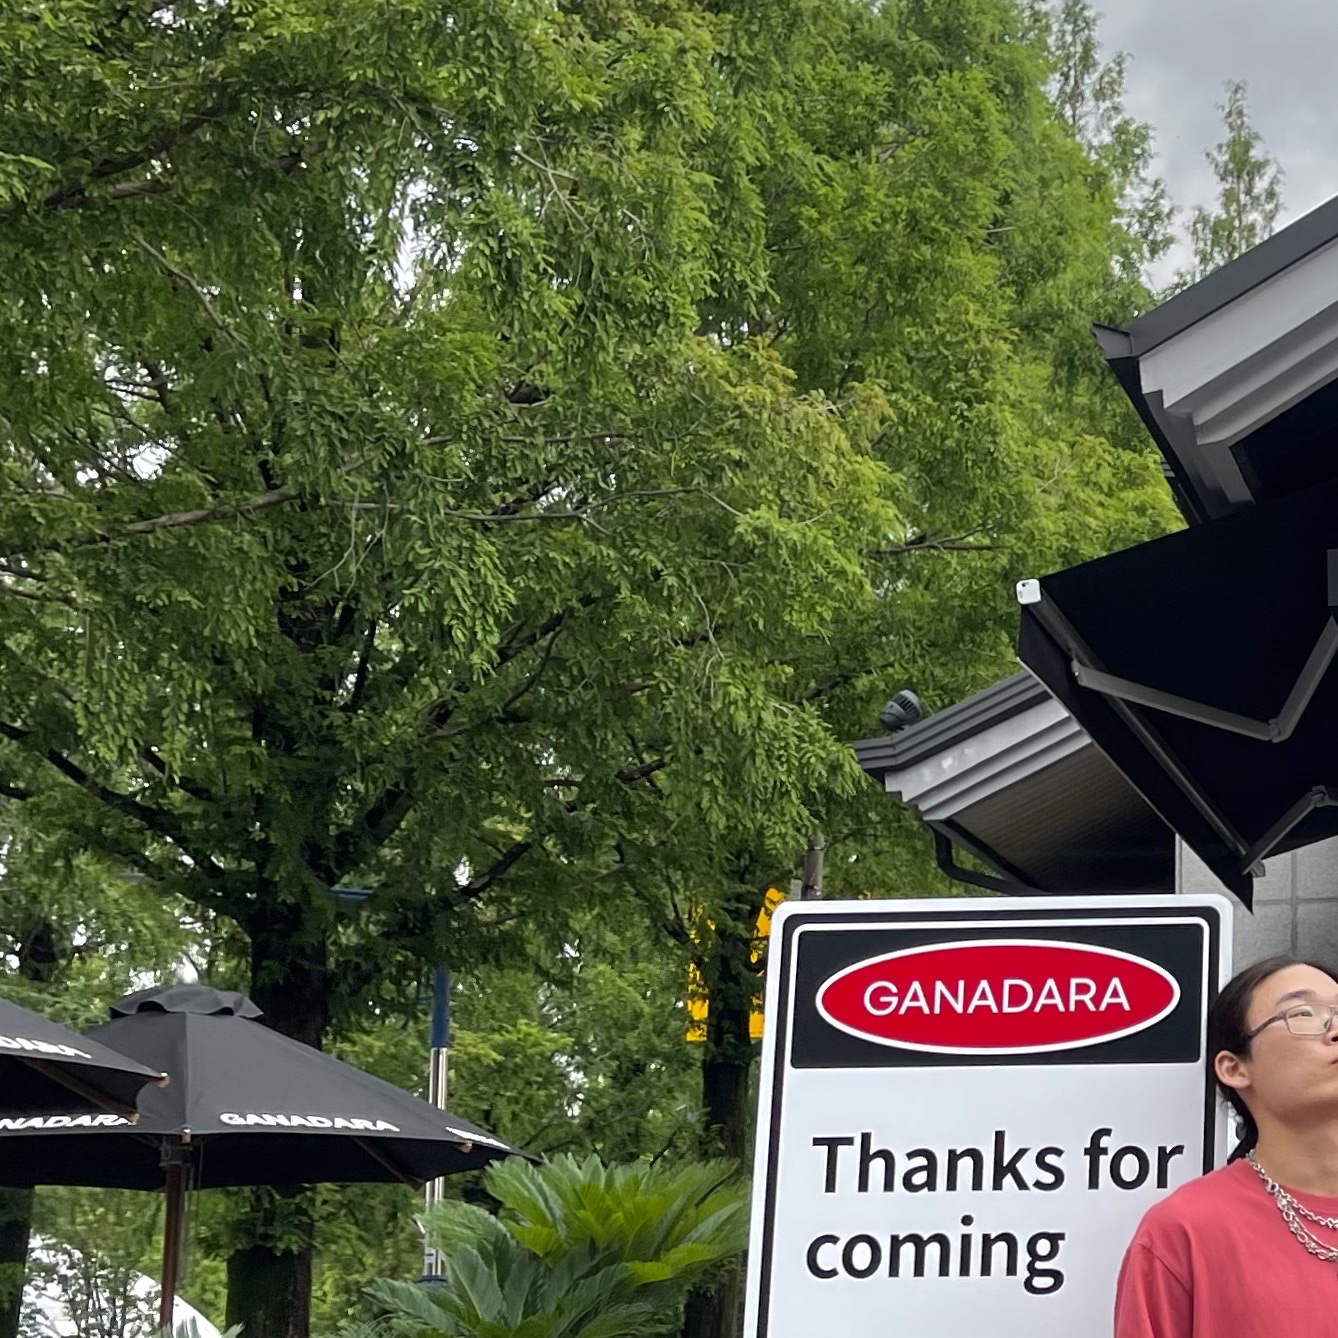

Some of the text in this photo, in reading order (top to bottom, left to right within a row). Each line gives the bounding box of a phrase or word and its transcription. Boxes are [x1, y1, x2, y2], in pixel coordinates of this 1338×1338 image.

[863, 977, 1131, 1016] GANADARA
[219, 1113, 401, 1132] GANADARA
[812, 1128, 1185, 1194] Thanks for
[806, 1215, 1066, 1295] coming
